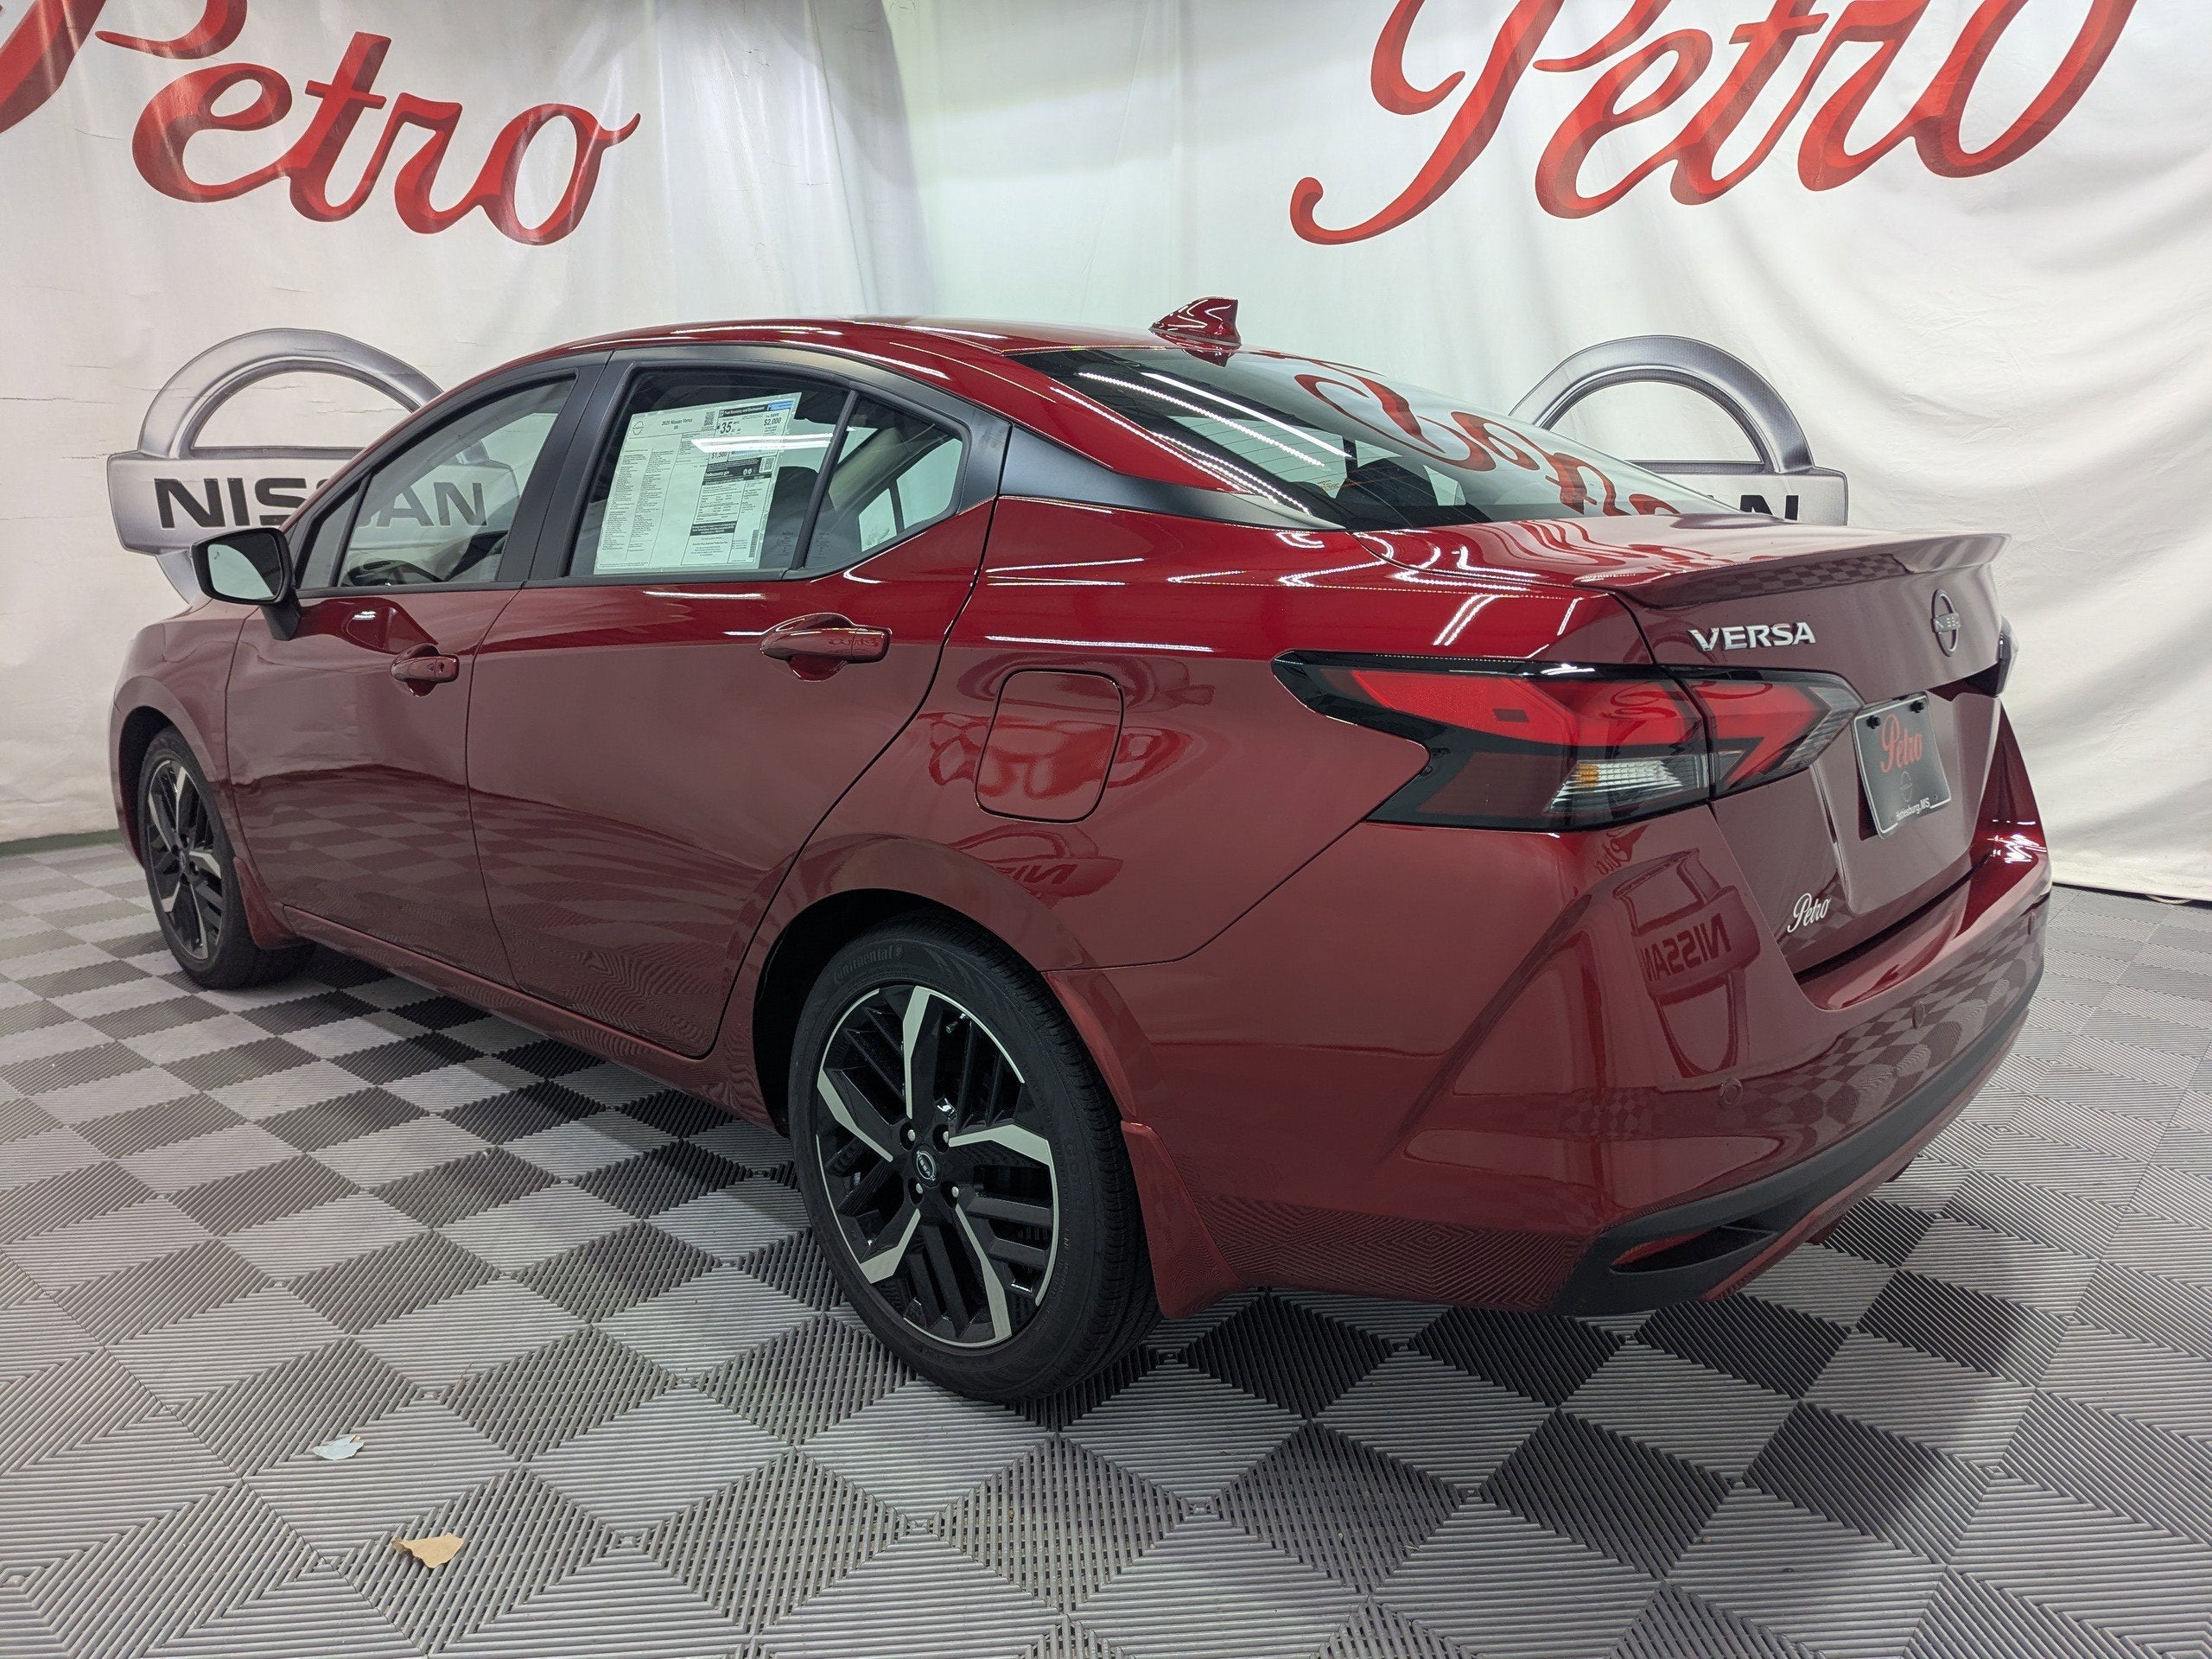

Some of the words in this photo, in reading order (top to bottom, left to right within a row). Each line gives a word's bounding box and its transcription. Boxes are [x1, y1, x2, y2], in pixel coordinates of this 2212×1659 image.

[720, 421, 733, 434] 35
[154, 478, 489, 529] NISAN
[1687, 621, 1816, 652] VERSA
[1880, 713, 1923, 773] Petro
[1787, 893, 1832, 933] Petro
